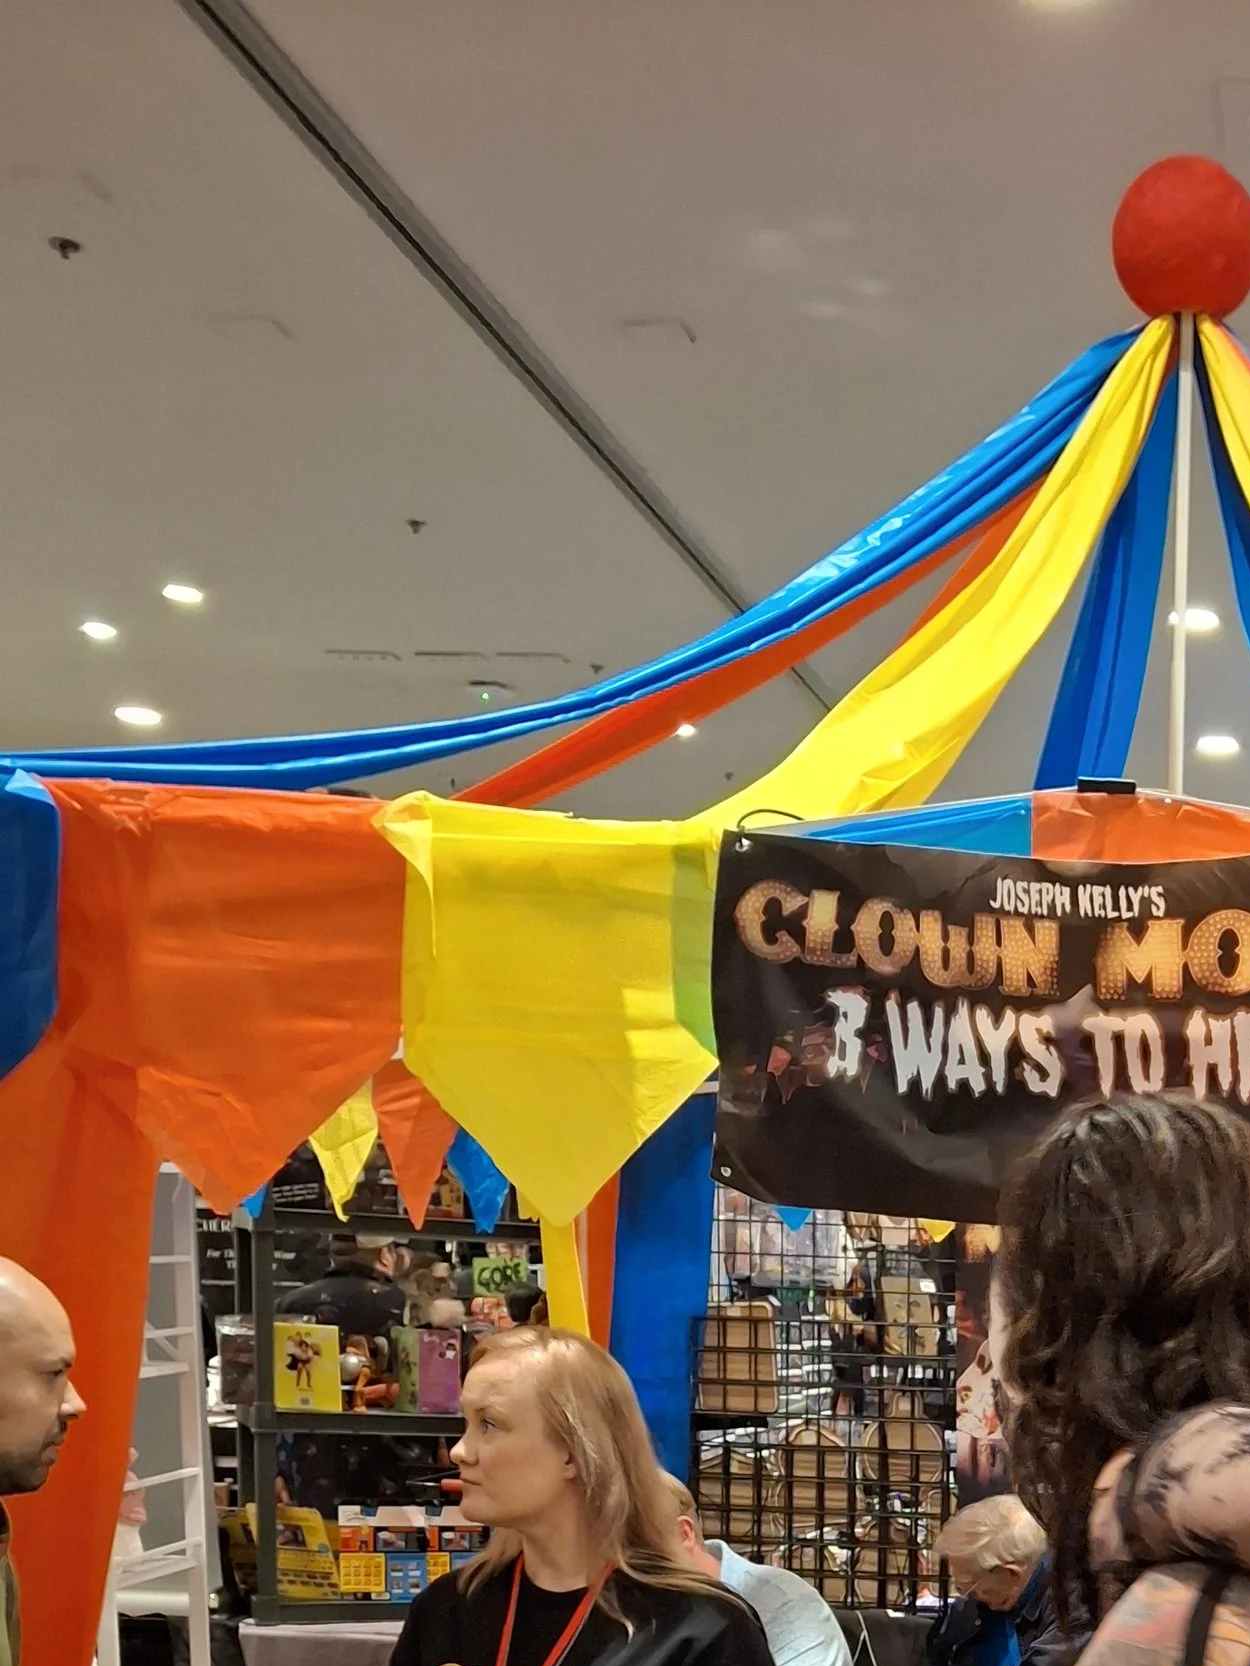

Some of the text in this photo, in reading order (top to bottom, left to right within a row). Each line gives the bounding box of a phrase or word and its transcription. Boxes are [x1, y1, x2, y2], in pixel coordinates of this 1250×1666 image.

[733, 878, 1061, 997] CLOWN
[989, 876, 1167, 918] JOSEPH KELLY'S
[885, 996, 1063, 1101] WAYS
[1082, 1011, 1164, 1100] TO
